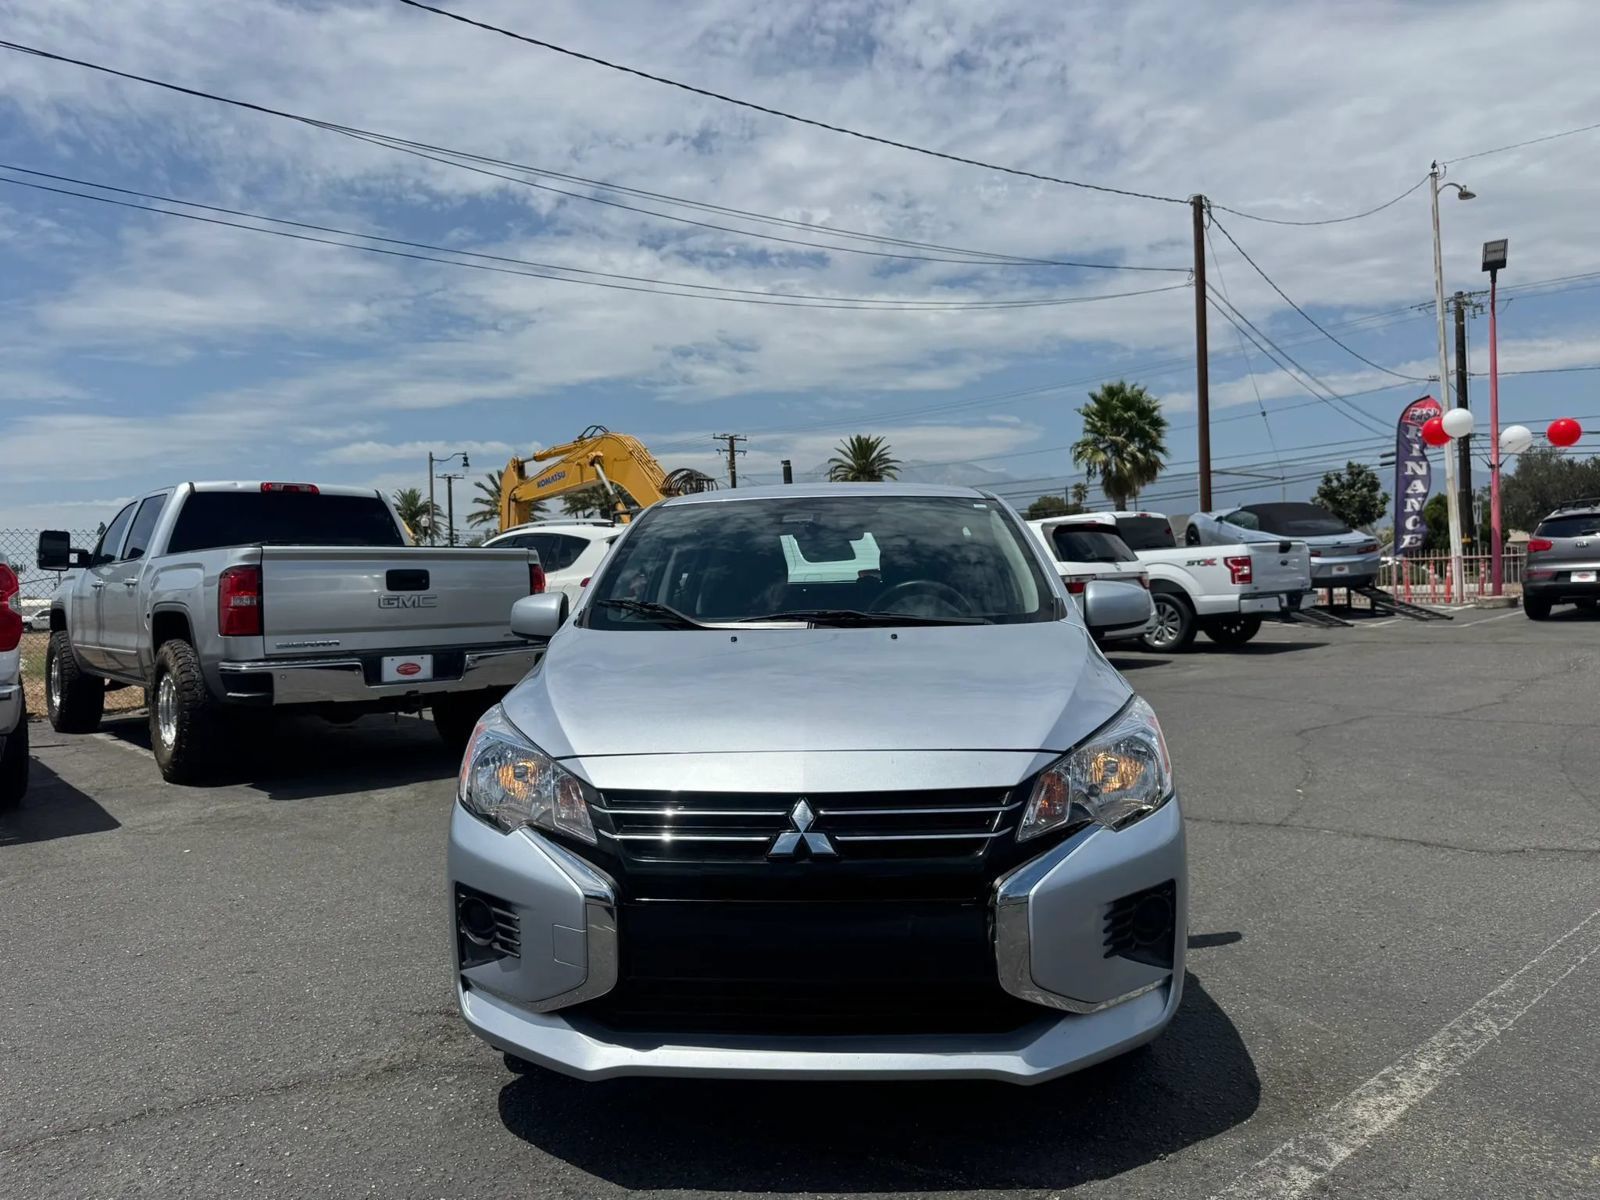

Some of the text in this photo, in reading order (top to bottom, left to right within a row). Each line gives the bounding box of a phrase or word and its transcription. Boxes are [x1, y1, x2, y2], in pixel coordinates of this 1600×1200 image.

[537, 470, 566, 488] KOMATSU
[1185, 558, 1217, 567] STX
[378, 594, 438, 609] GMC
